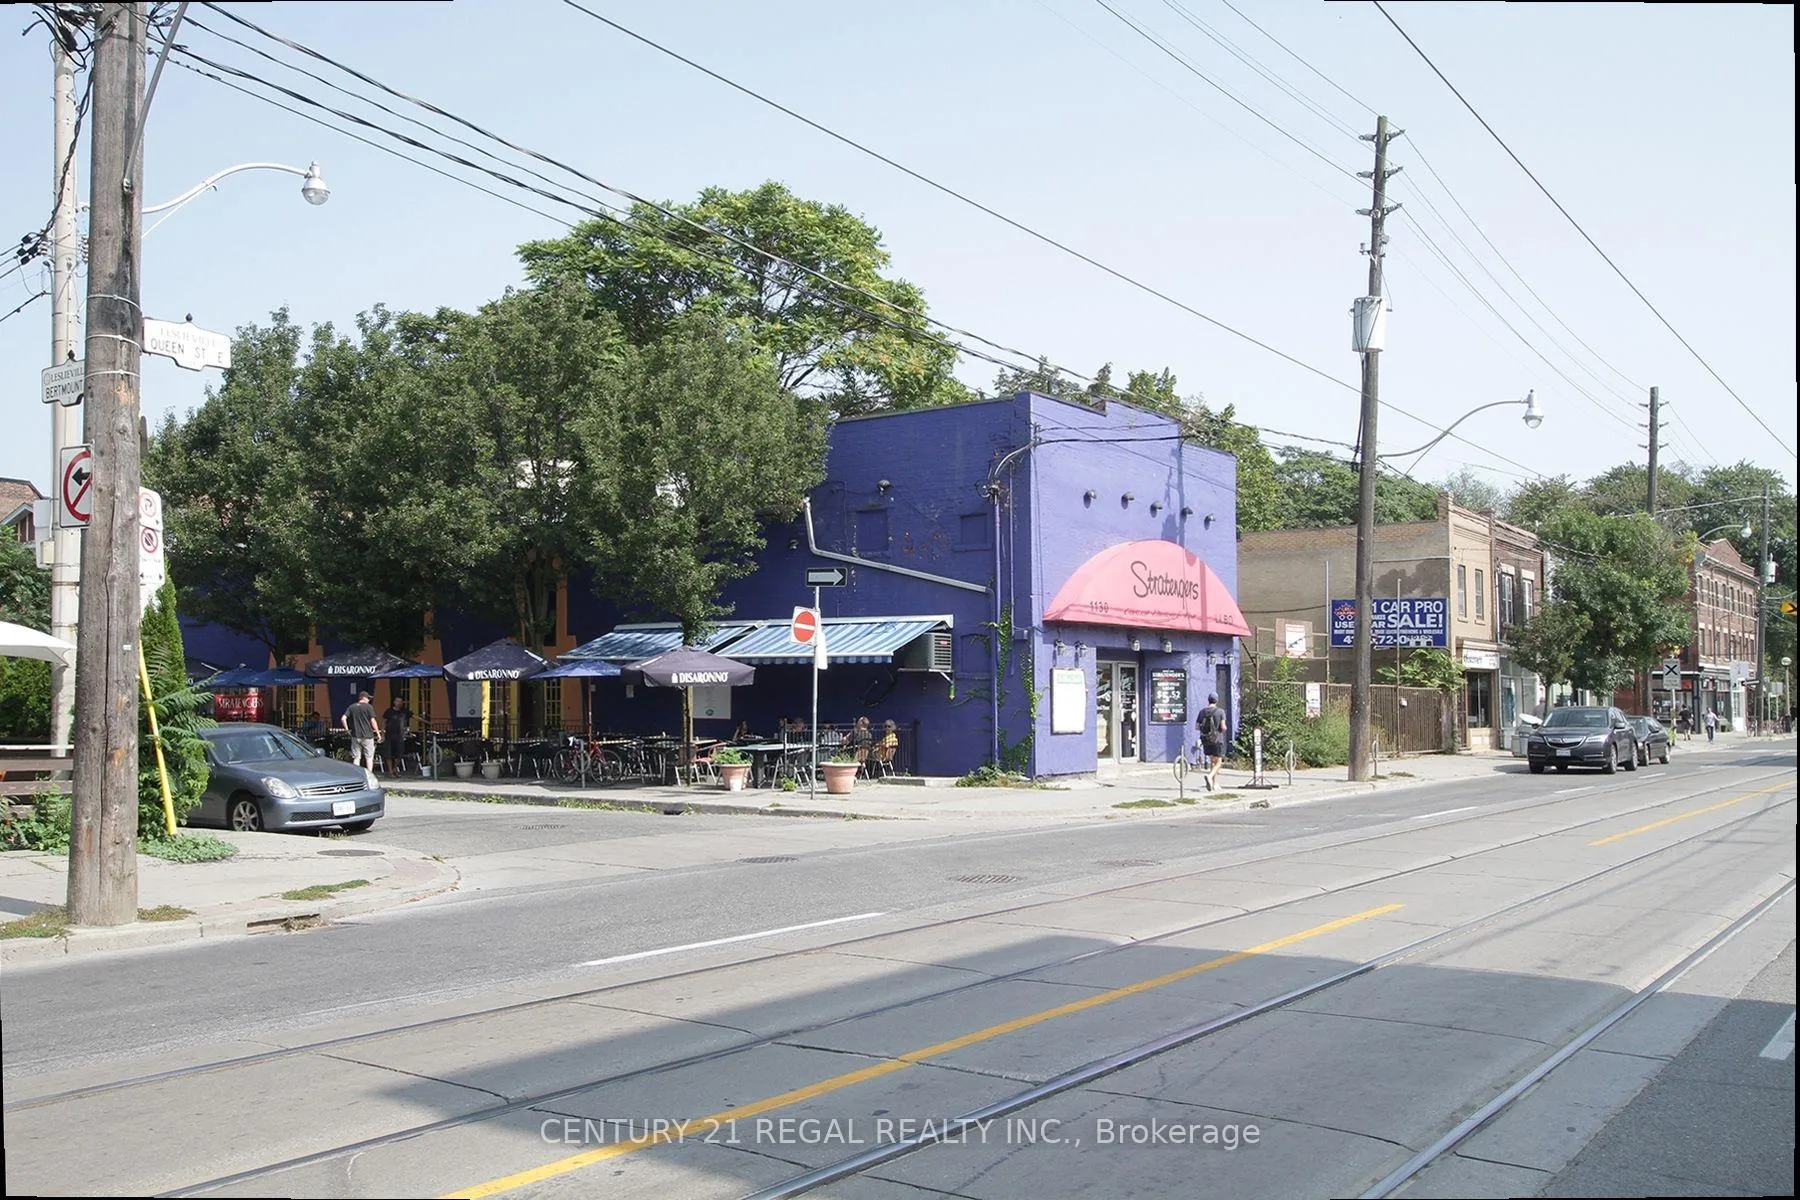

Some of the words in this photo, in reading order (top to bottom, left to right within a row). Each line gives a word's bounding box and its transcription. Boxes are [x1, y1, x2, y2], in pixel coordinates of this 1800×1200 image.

[150, 337, 185, 354] QUEEN
[194, 346, 205, 359] ST
[217, 351, 224, 364] E
[51, 366, 83, 382] LESLIEVILL
[1380, 601, 1411, 613] CAR
[1414, 601, 1444, 613] PRO
[1334, 621, 1356, 629] USE
[1371, 621, 1386, 629] AR
[1386, 613, 1444, 628] SALE!
[333, 665, 376, 675] DISARONNO
[475, 669, 519, 680] DISARONNO
[679, 671, 728, 683] DISARONNO
